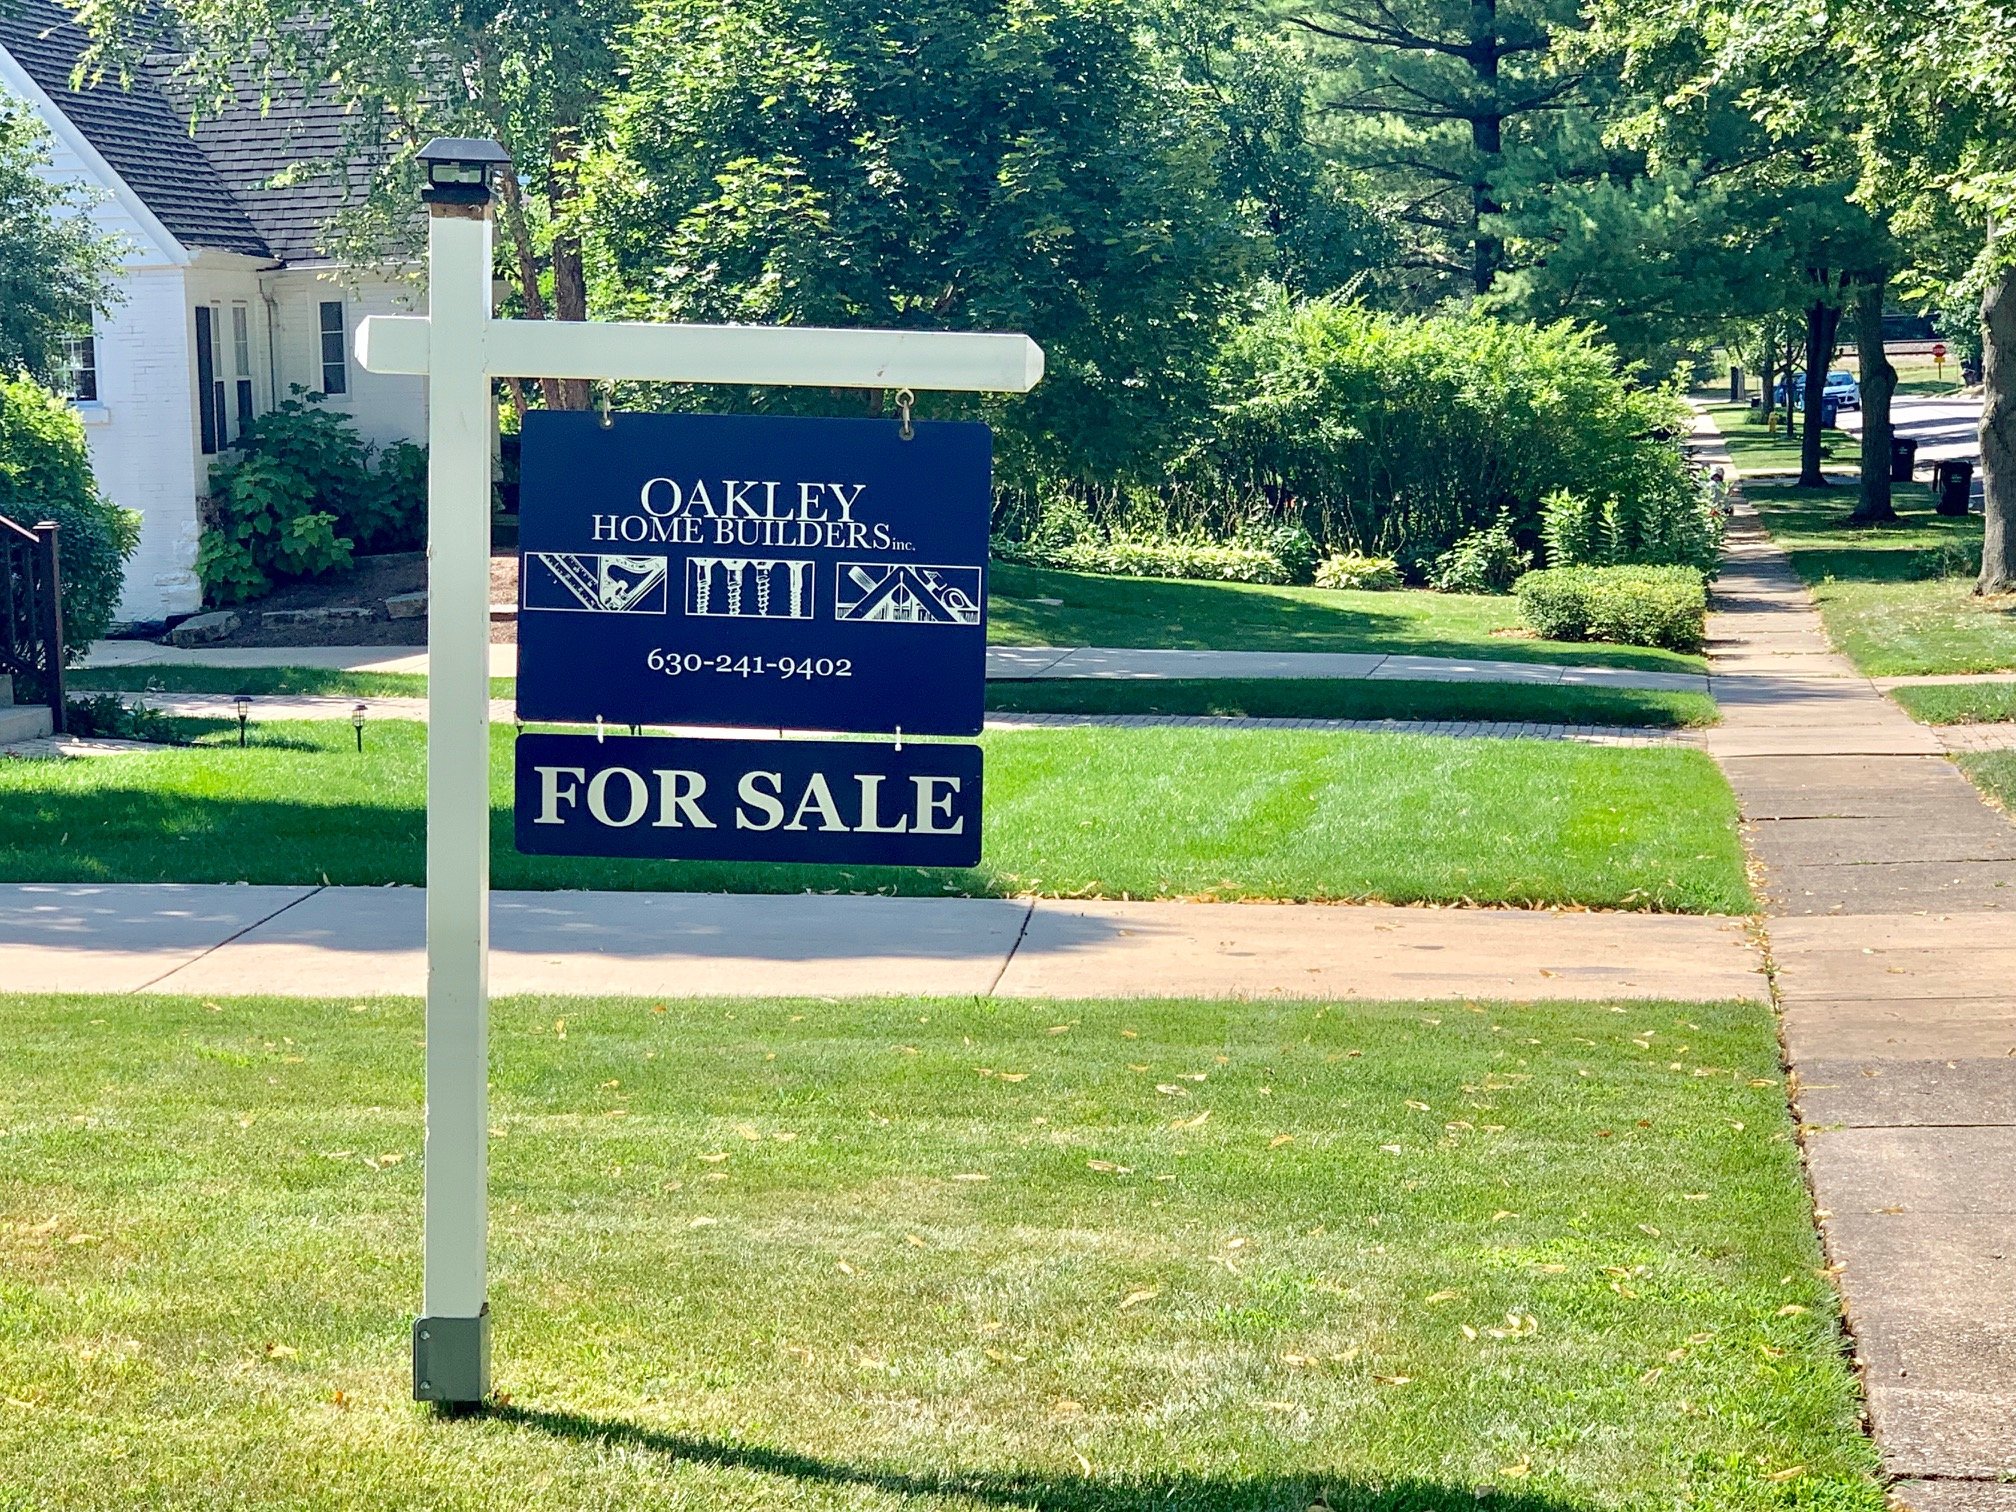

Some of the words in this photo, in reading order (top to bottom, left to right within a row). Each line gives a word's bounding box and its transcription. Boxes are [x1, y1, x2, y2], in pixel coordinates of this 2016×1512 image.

[640, 477, 867, 523] OAKLEY
[591, 514, 705, 545] HOME
[713, 518, 893, 551] BUILDERS
[892, 536, 916, 551] inc.
[646, 647, 853, 679] 630-241-9402
[533, 766, 718, 829] FOR
[736, 770, 964, 835] SALE
